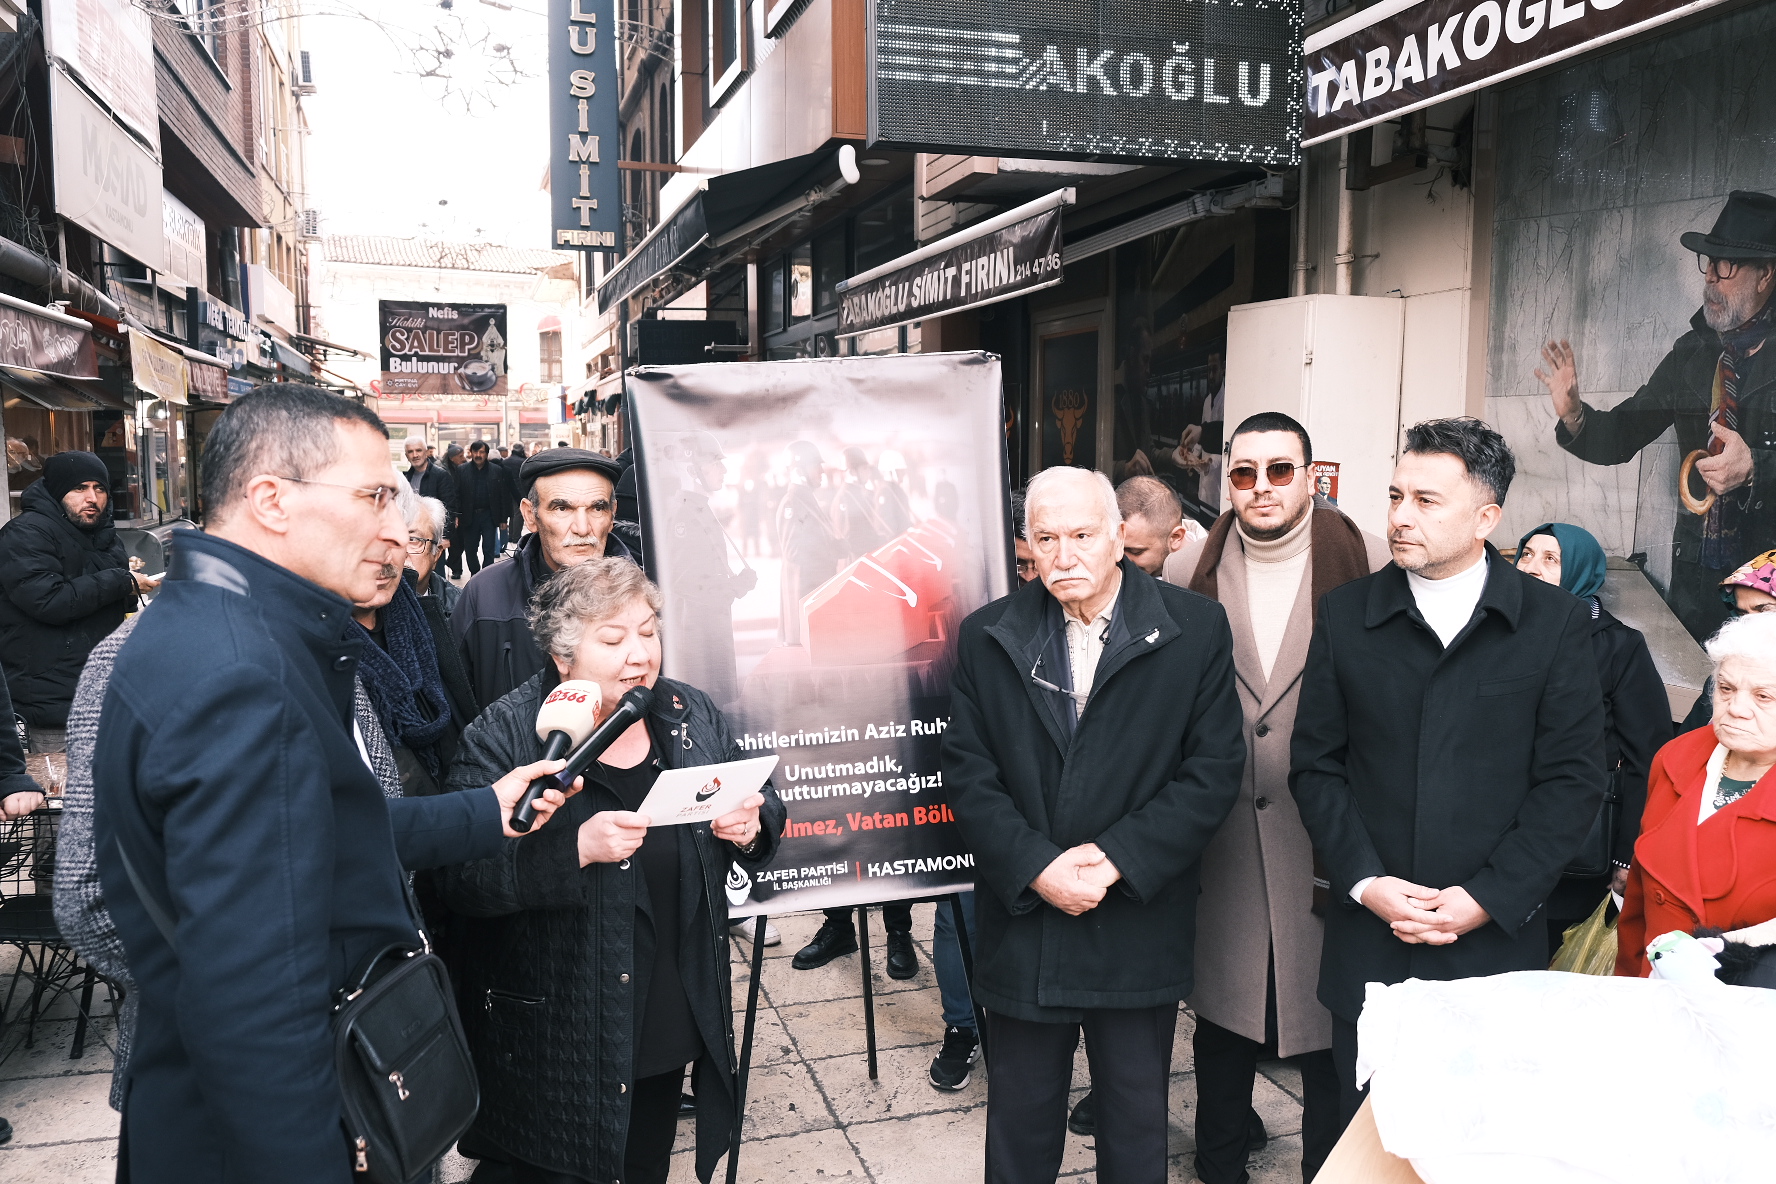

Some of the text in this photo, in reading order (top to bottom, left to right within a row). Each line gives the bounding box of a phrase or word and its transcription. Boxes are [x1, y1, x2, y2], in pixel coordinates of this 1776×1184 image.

[557, 229, 615, 247] FIRINI
[910, 261, 957, 308] SİMİT
[960, 246, 1016, 297] FIRINI
[1016, 260, 1031, 281] 214
[386, 315, 426, 328] Hakiki
[428, 307, 459, 320] Nefis
[388, 327, 479, 357] SALEP
[389, 356, 459, 374] Bulunur
[735, 716, 951, 751] ehitlerimizin Aziz Ruh
[784, 754, 903, 782] Unutmadık,
[775, 771, 943, 802] utturmayacağız!
[680, 804, 712, 813] ZAFER
[780, 817, 843, 839] lmez,
[846, 811, 909, 832] Vatan
[756, 868, 797, 884] ZAFER
[801, 860, 849, 878] PARTİSİ
[773, 876, 832, 891] İL BAŞKANLIĞI
